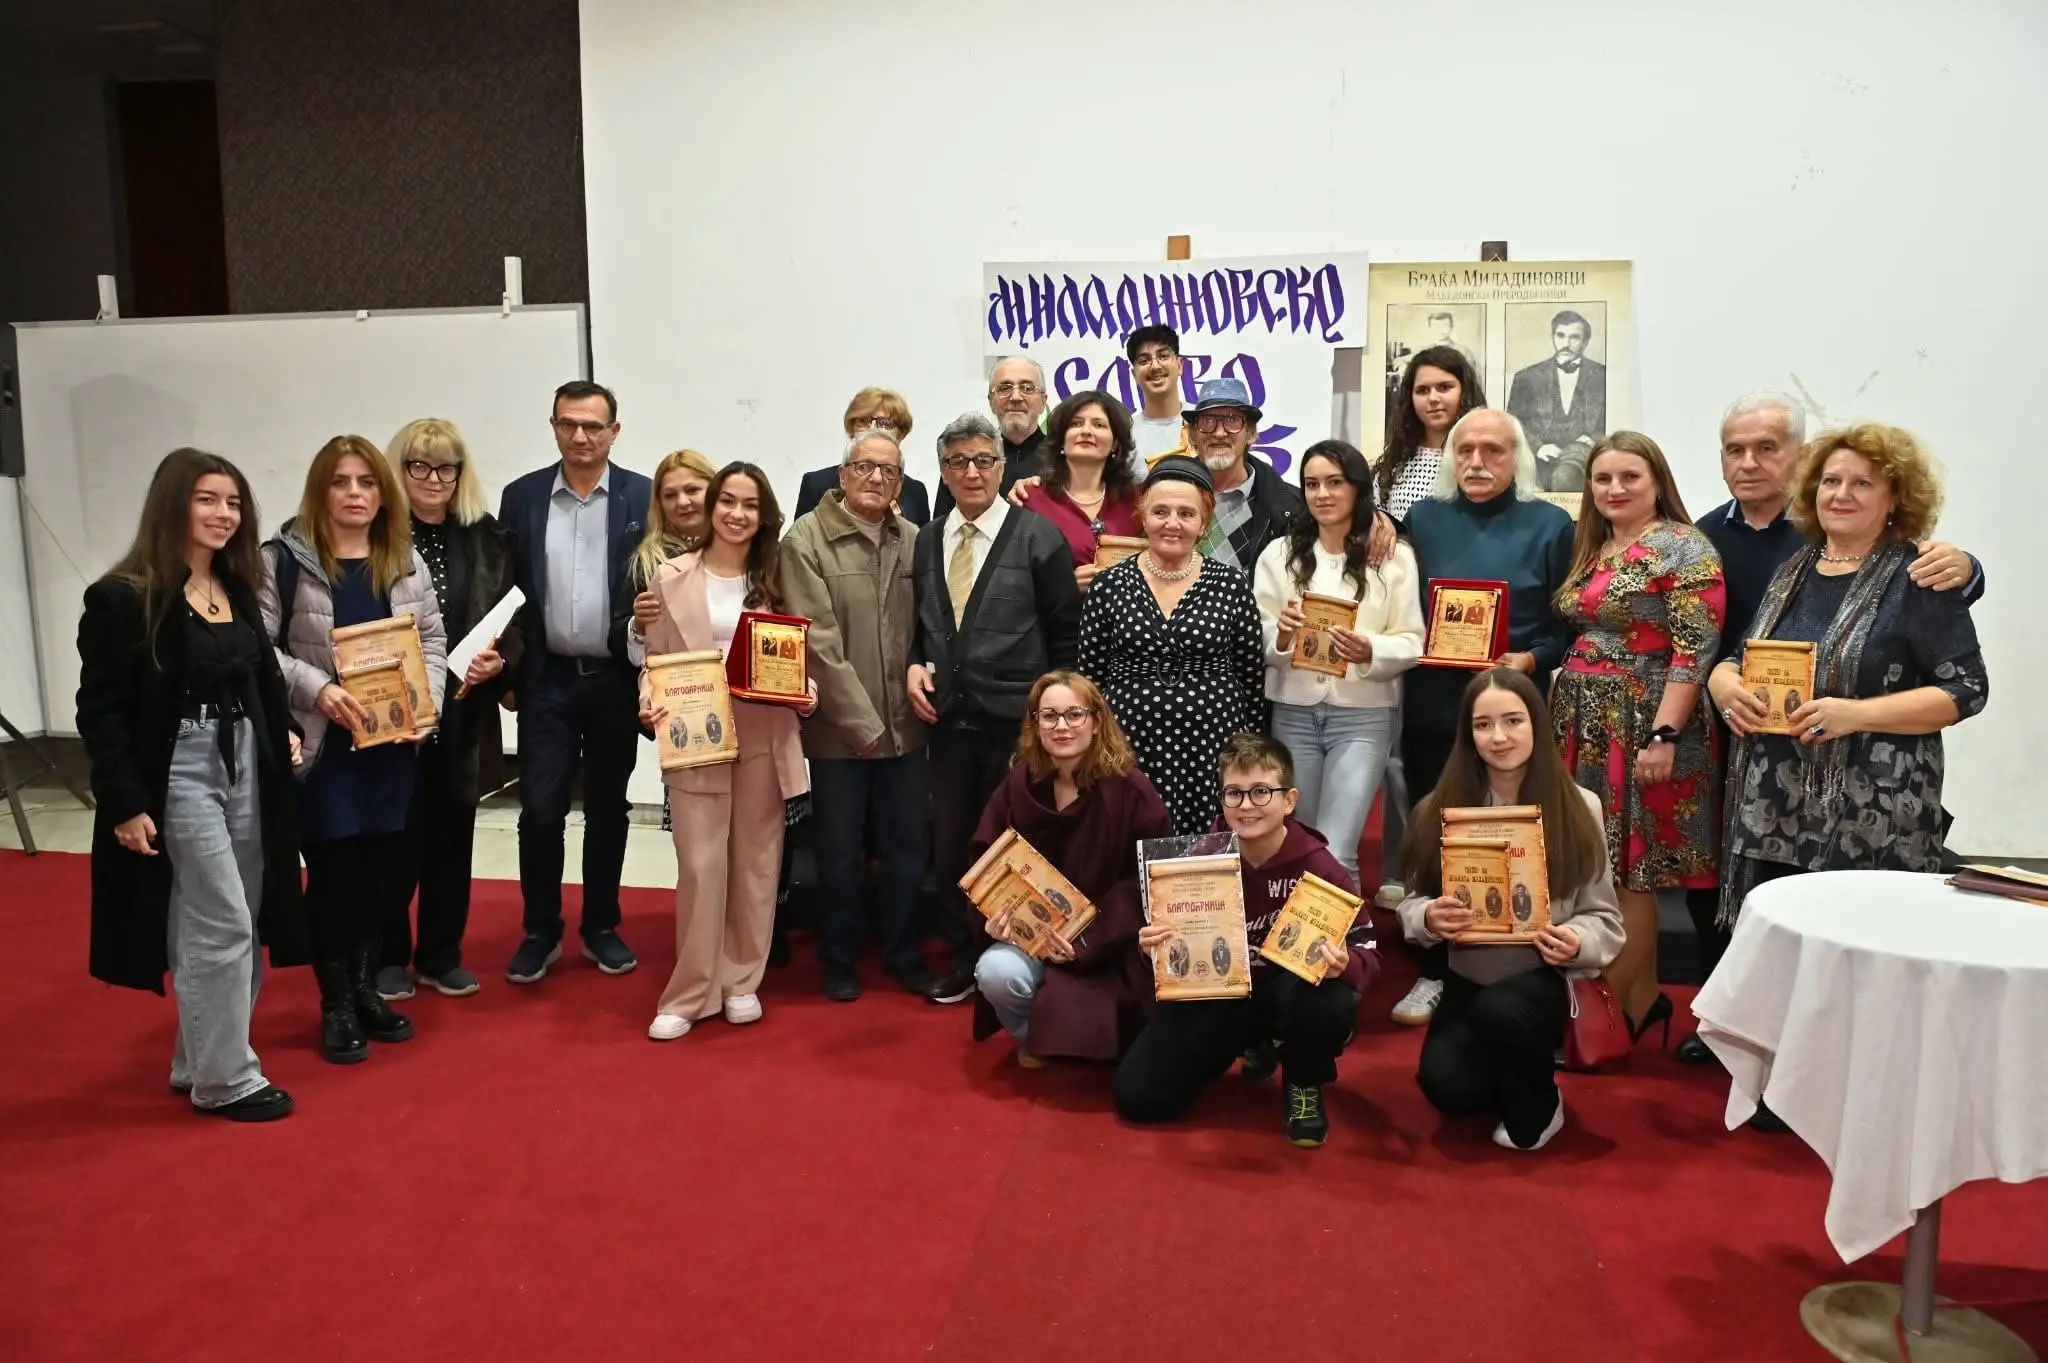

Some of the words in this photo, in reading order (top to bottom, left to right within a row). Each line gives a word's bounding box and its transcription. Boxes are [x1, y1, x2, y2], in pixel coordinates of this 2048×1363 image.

[1463, 270, 1585, 287] МИЛАДИНОВЦИ
[665, 683, 714, 697] БЛАГОДАРНИЦА
[1167, 900, 1225, 913] БЛАГОДАРНИЦА
